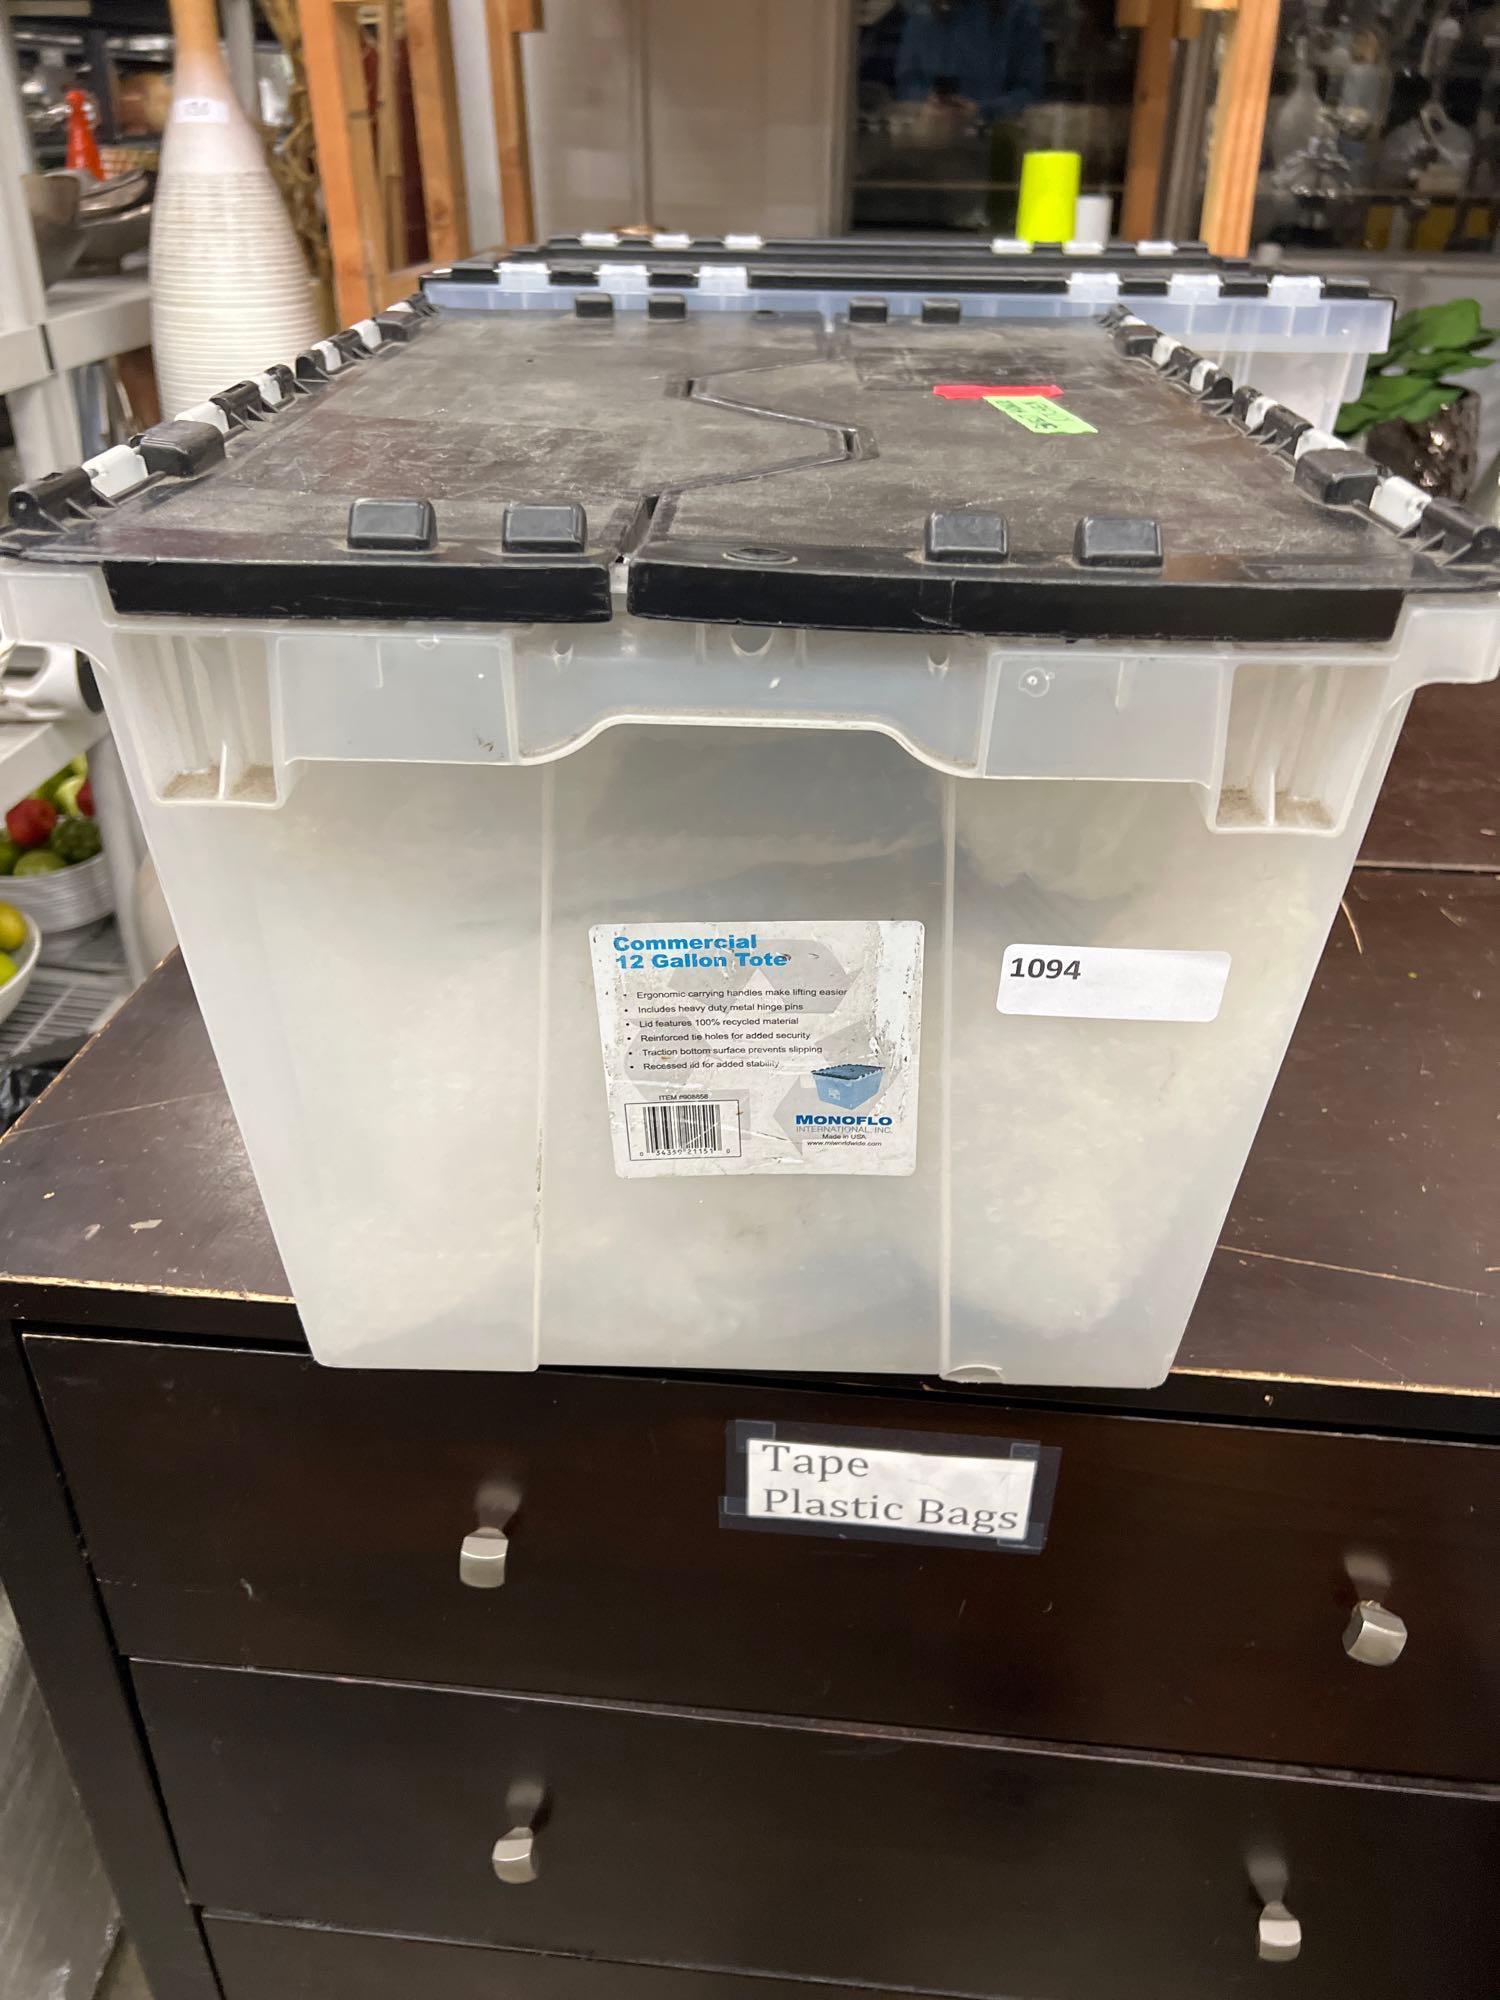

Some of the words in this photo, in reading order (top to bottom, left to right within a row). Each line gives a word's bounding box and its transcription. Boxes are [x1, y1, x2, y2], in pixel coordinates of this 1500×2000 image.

[613, 934, 757, 952] Commercial
[615, 954, 644, 969] 12
[652, 953, 727, 968] Gallon
[735, 952, 788, 967] Tote
[1010, 957, 1081, 980] 1094
[636, 991, 686, 1000] Ergonomic
[688, 989, 725, 999] carrying
[727, 989, 763, 997] handles
[765, 988, 790, 996] make
[792, 988, 817, 997] lifting
[638, 1005, 676, 1013] Includes
[678, 1004, 706, 1013] heavy
[708, 1004, 728, 1012] duty
[730, 1003, 755, 1011] metal
[757, 1003, 782, 1012] hinge
[784, 1003, 804, 1011] pins
[639, 1020, 653, 1028] Lid
[695, 1018, 720, 1026] 100%
[722, 1018, 760, 1027] recycled
[762, 1017, 799, 1025] material
[640, 1034, 689, 1042] Reinforced
[704, 1032, 729, 1040] holes
[775, 1032, 811, 1040] security
[643, 1048, 678, 1056] Traction
[680, 1047, 711, 1055] bottom
[712, 1046, 746, 1054] surface
[748, 1046, 786, 1054] prevents
[788, 1045, 823, 1055] slipping
[643, 1062, 687, 1070] Recessed
[702, 1060, 714, 1068] for
[795, 1115, 893, 1126] MONOFLO
[762, 1444, 870, 1483] Tape
[764, 1488, 904, 1522] Plastic
[917, 1498, 1019, 1535] Bags
